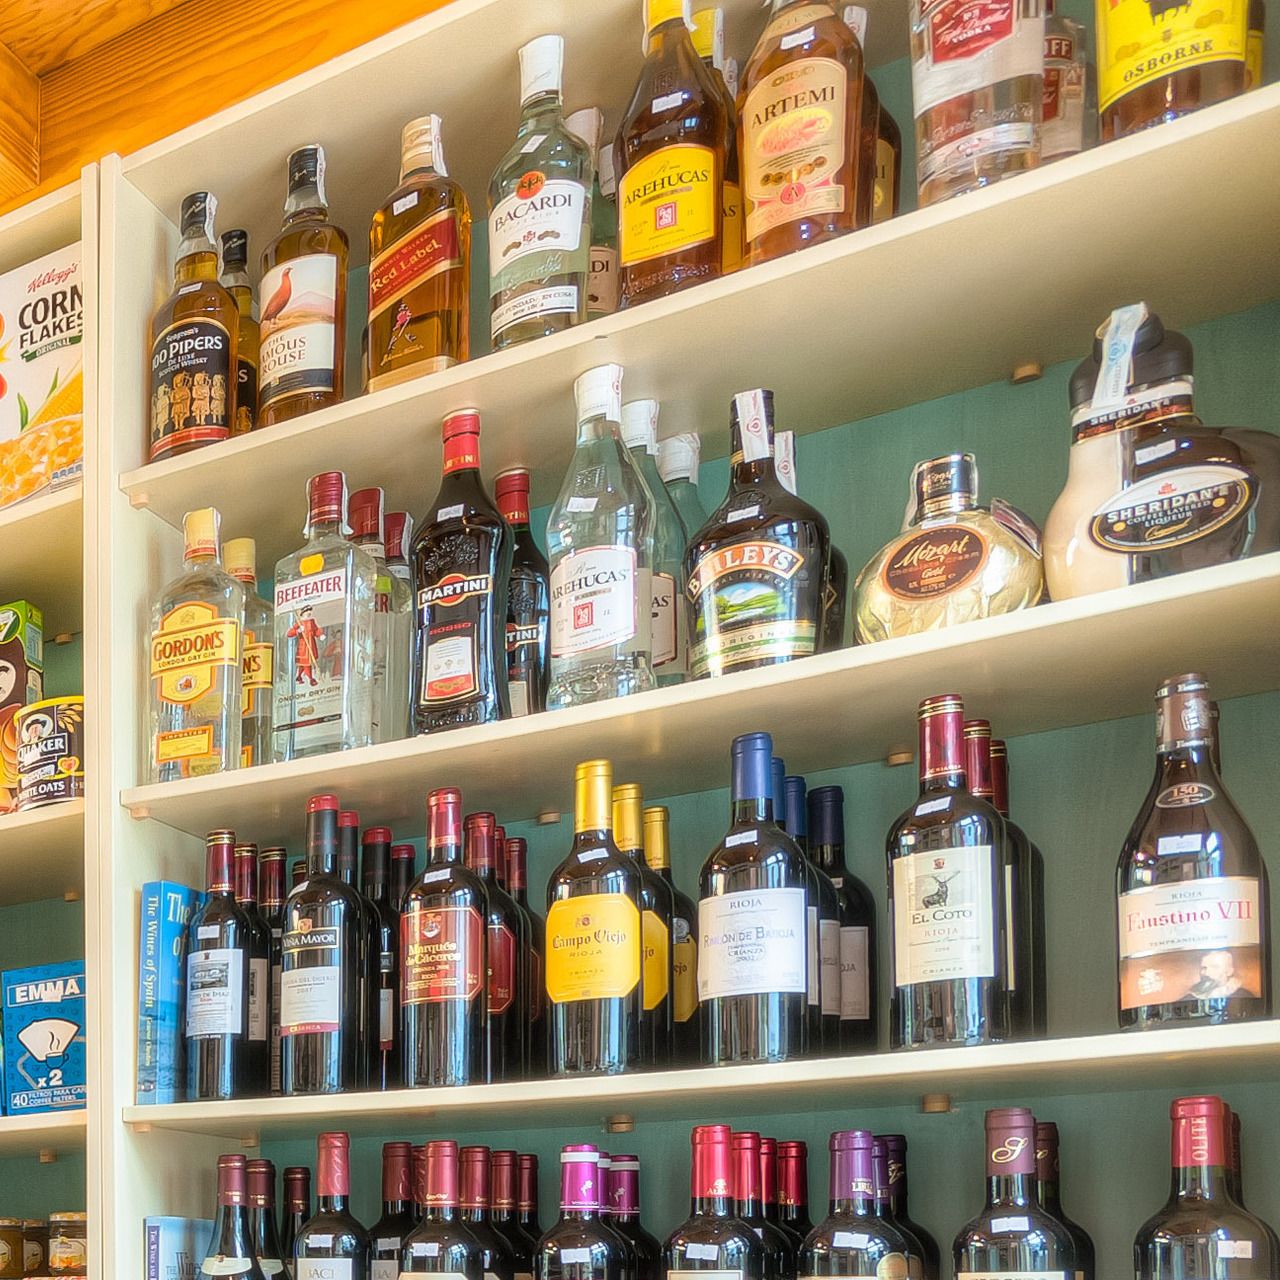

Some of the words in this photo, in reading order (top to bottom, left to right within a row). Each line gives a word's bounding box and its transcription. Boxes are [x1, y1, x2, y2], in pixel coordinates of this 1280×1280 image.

[951, 24, 992, 44] VODKA
[1122, 38, 1214, 83] OSBORNE
[751, 86, 835, 128] ARTEMI
[624, 170, 709, 207] AREHUCAS
[495, 195, 572, 232] BACARDI
[27, 262, 79, 294] Kellogg's
[370, 268, 397, 294] Red
[400, 240, 442, 271] Label
[18, 284, 83, 330] CORN
[170, 336, 222, 358] PIPERS
[267, 334, 285, 347] THE
[1106, 484, 1230, 524] SHERIDAN'S
[1127, 509, 1164, 526] COFFEE
[1165, 500, 1211, 518] LAYERED
[1144, 511, 1194, 528] LIQUEUR
[894, 535, 968, 569] Mozart
[276, 575, 342, 607] BEEFEATER
[421, 578, 487, 602] MARTINI
[552, 569, 627, 602] AREHUCAS
[154, 631, 224, 661] GORDON'S
[158, 657, 186, 669] LONDON
[188, 654, 201, 663] DRY
[309, 688, 326, 697] DRY
[39, 781, 65, 794] OATS
[1172, 785, 1199, 798] 150
[148, 896, 158, 917] The
[167, 893, 190, 923] The
[729, 898, 763, 910] RIOJA
[912, 913, 929, 925] EL
[933, 909, 972, 922] COTO
[1127, 909, 1211, 934] Faustino
[1217, 900, 1253, 921] VII
[145, 920, 158, 959] Wines
[300, 933, 336, 944] MAYOR
[552, 929, 592, 950] Campo
[594, 929, 627, 946] Viejo
[924, 927, 958, 937] RIOJA
[408, 942, 456, 956] Marqués
[143, 962, 155, 971] of
[15, 979, 80, 1003] EMMA
[145, 974, 157, 1008] Spain
[13, 1094, 28, 1107] 40
[28, 1089, 53, 1099] FILTROS
[28, 1097, 52, 1106] COFFEE
[53, 1095, 76, 1103] FILTERS
[1192, 1115, 1209, 1162] OLITE
